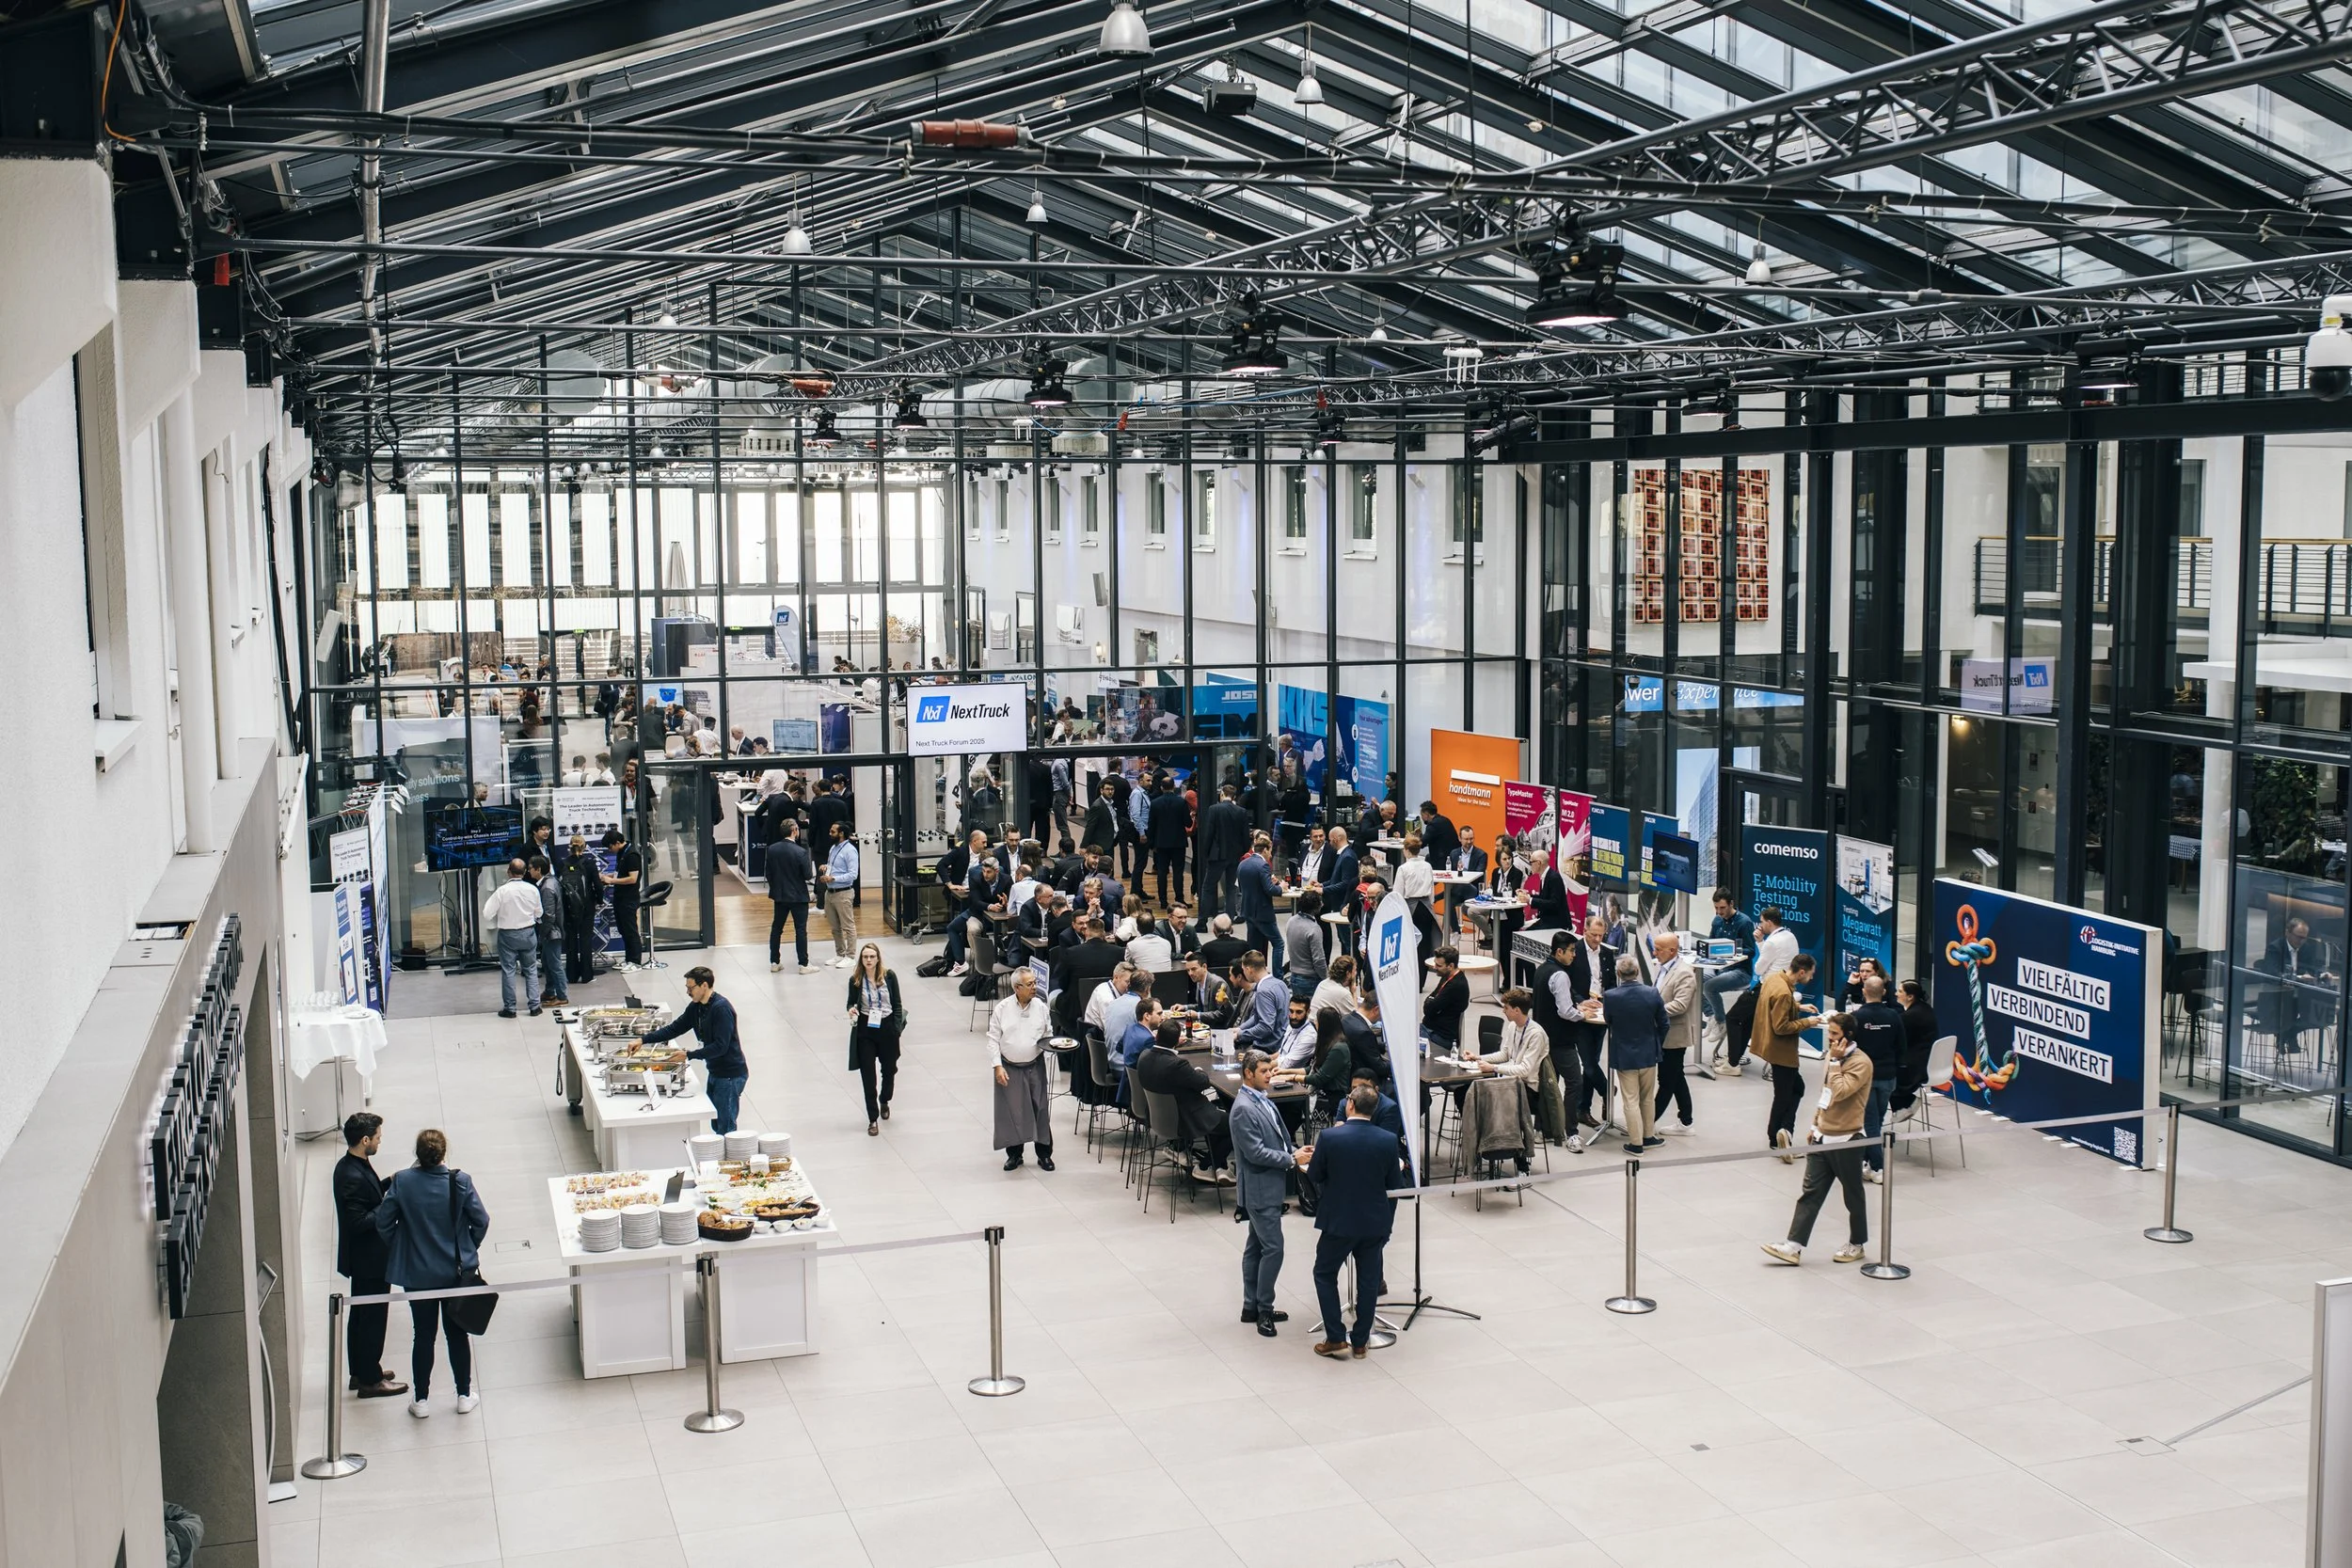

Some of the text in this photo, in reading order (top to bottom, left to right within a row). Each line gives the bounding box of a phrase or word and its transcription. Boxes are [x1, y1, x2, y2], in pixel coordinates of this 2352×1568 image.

[922, 705, 944, 721] NxT
[950, 704, 1010, 719] NextTruck
[418, 773, 460, 787] solutions
[1449, 782, 1491, 799] handtmann
[1507, 788, 1534, 798] TypeMaster
[1754, 843, 1819, 860] comemso
[1754, 873, 1817, 895] E-Mobility
[1754, 888, 1797, 909] Testing
[1754, 903, 1810, 923] Sotions
[1842, 905, 1858, 916] Testing
[1842, 914, 1882, 937] Megawatt
[1842, 929, 1880, 954] Charging
[2090, 944, 2116, 957] HAMBURG
[2091, 937, 2139, 955] LOGISTIK-INITIATIVE
[1378, 961, 1400, 982] NextTruck
[2023, 965, 2105, 1006] VIELFÄLTIG
[1991, 988, 2085, 1033] VERBINDEND
[2017, 1031, 2108, 1076] VERANKERT
